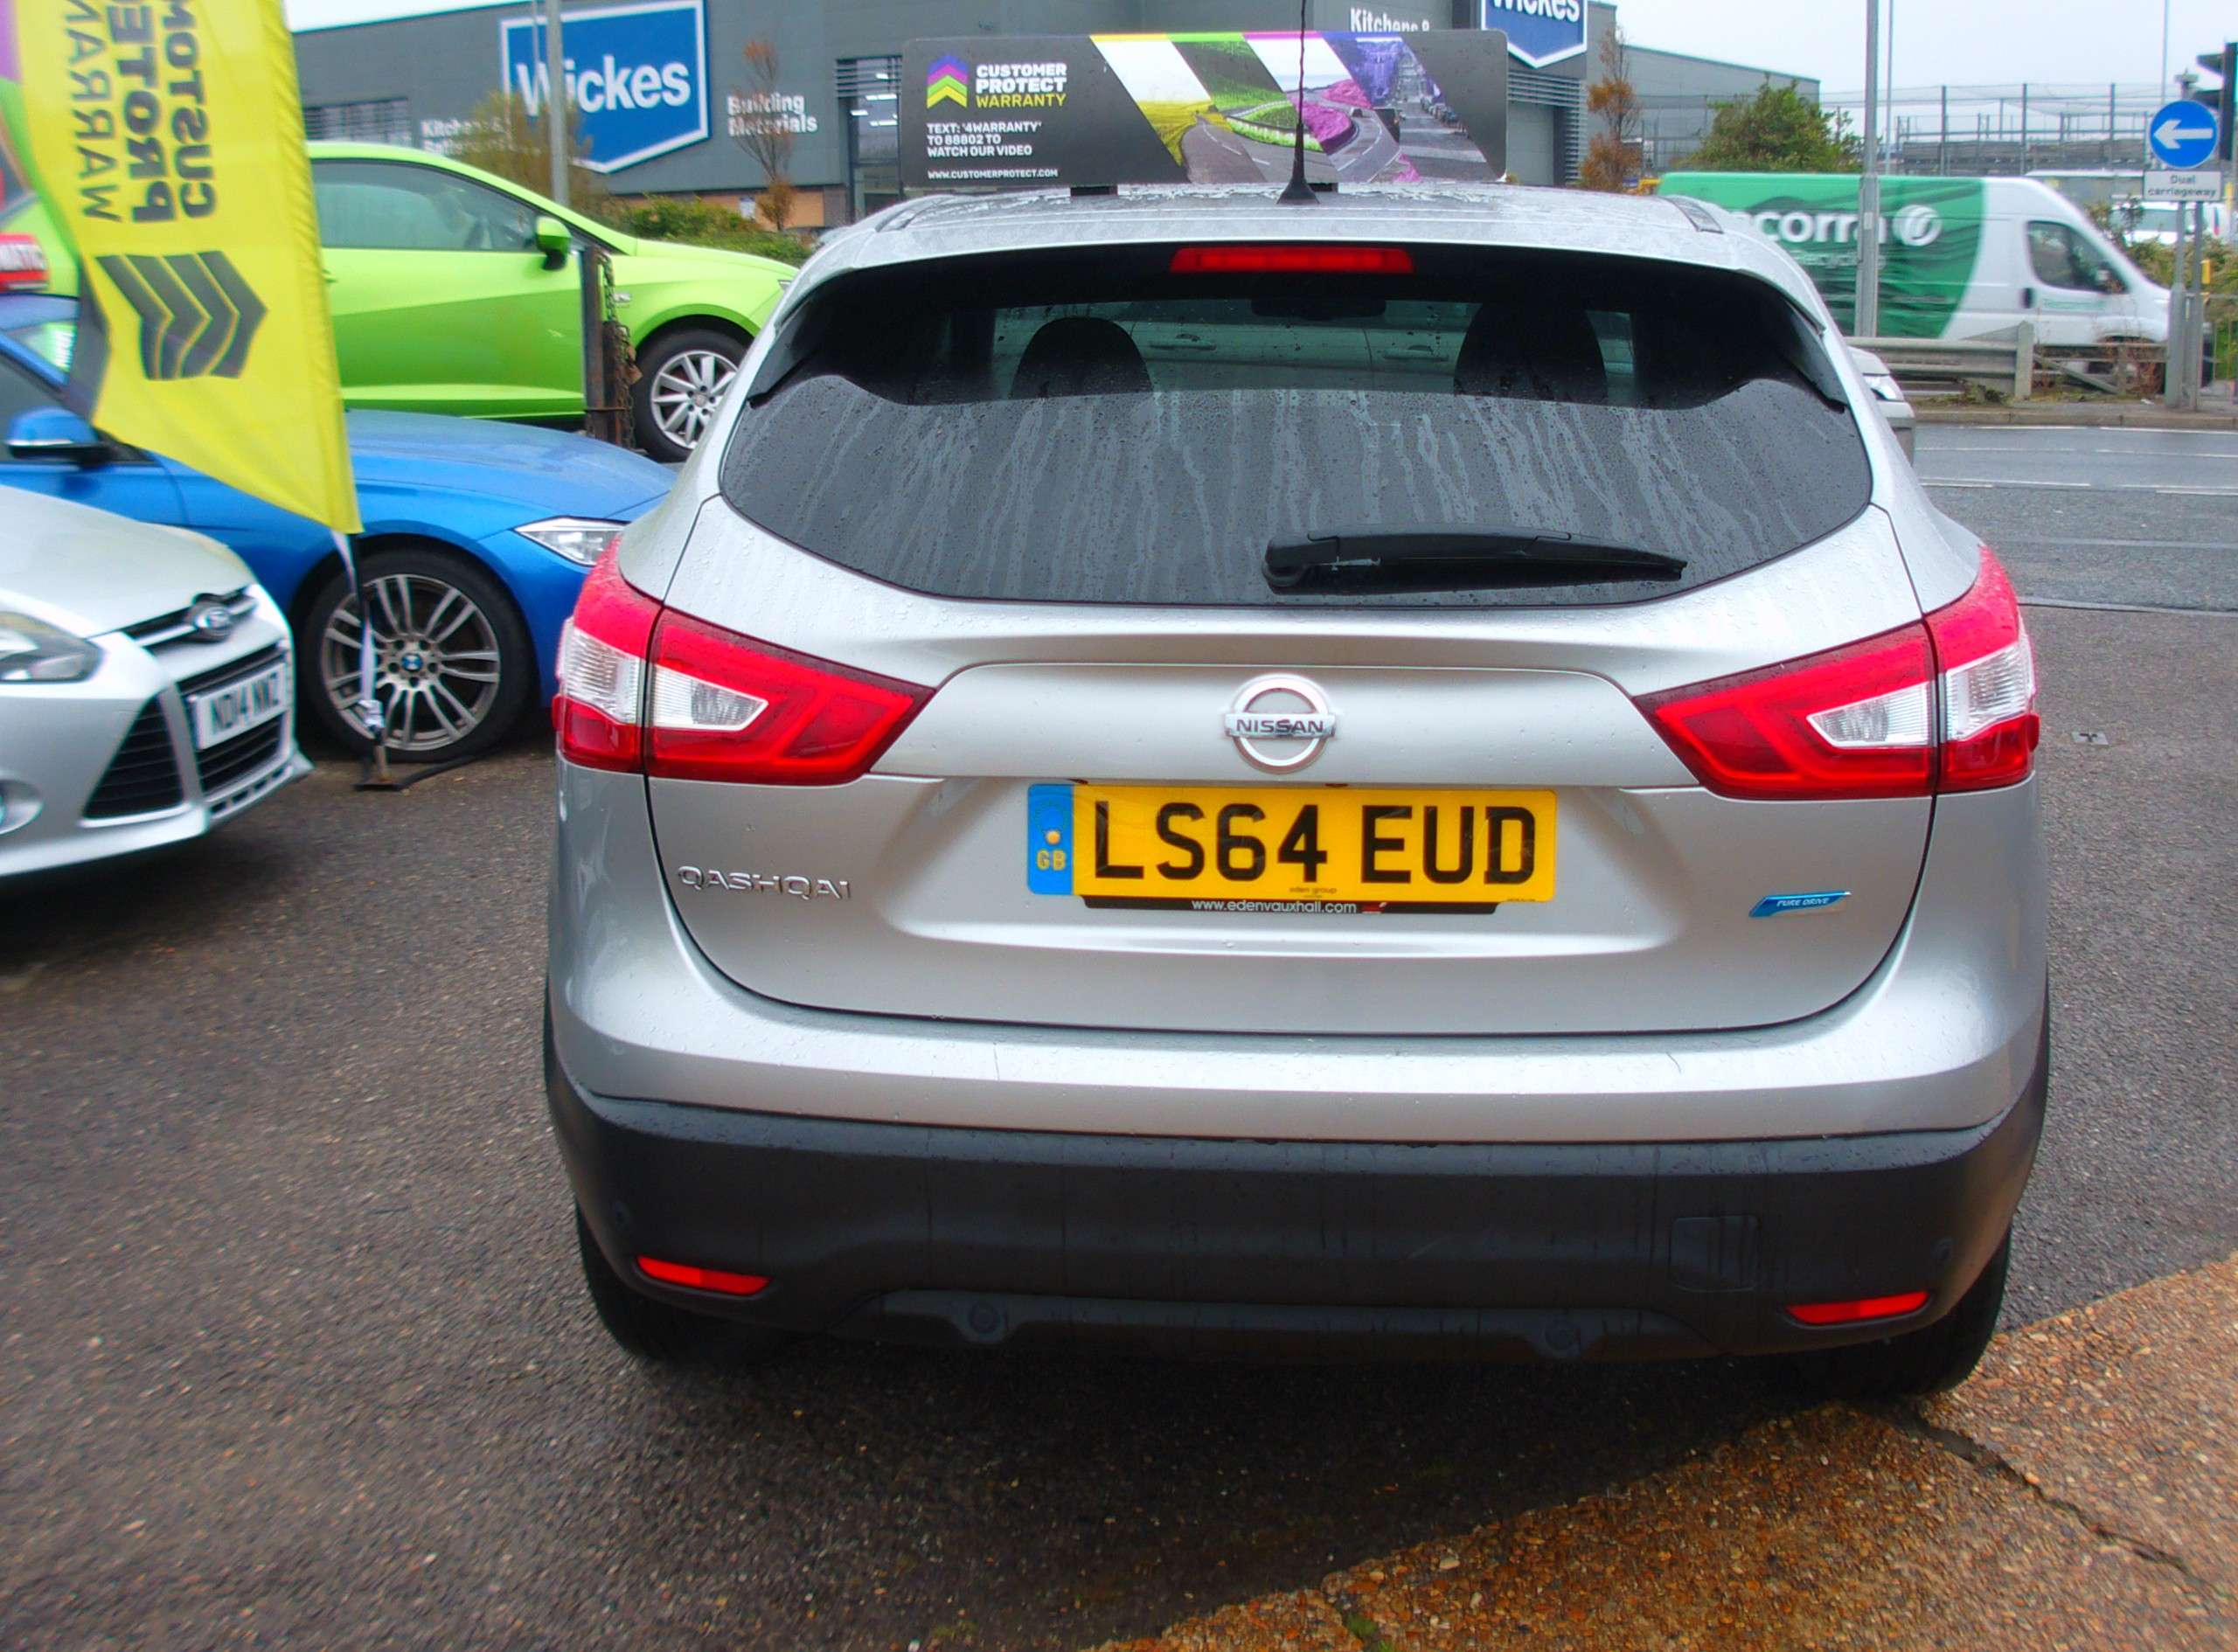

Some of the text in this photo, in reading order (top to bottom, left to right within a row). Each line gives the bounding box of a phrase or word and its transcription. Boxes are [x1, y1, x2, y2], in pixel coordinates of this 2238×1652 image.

[976, 62, 1067, 78] CUSTOMER
[975, 77, 1067, 94] PROTECT
[726, 91, 804, 115] Building
[976, 94, 1067, 108] WARRANTY
[927, 122, 960, 134] TEXT:
[927, 133, 1002, 145] TO 88802 TO
[927, 144, 1033, 157] WATCH OUR VIDEO
[928, 168, 1060, 179] WWW.CUSTOMERPROTECT.COM
[2169, 174, 2197, 185] Dual
[2147, 187, 2218, 198] carriageway
[1236, 718, 1324, 734] NISSAN
[1037, 802, 1536, 885] GB LS64 EUD
[678, 865, 851, 901] QASHQAI
[1191, 899, 1358, 914] www.edenvauxhall.com
